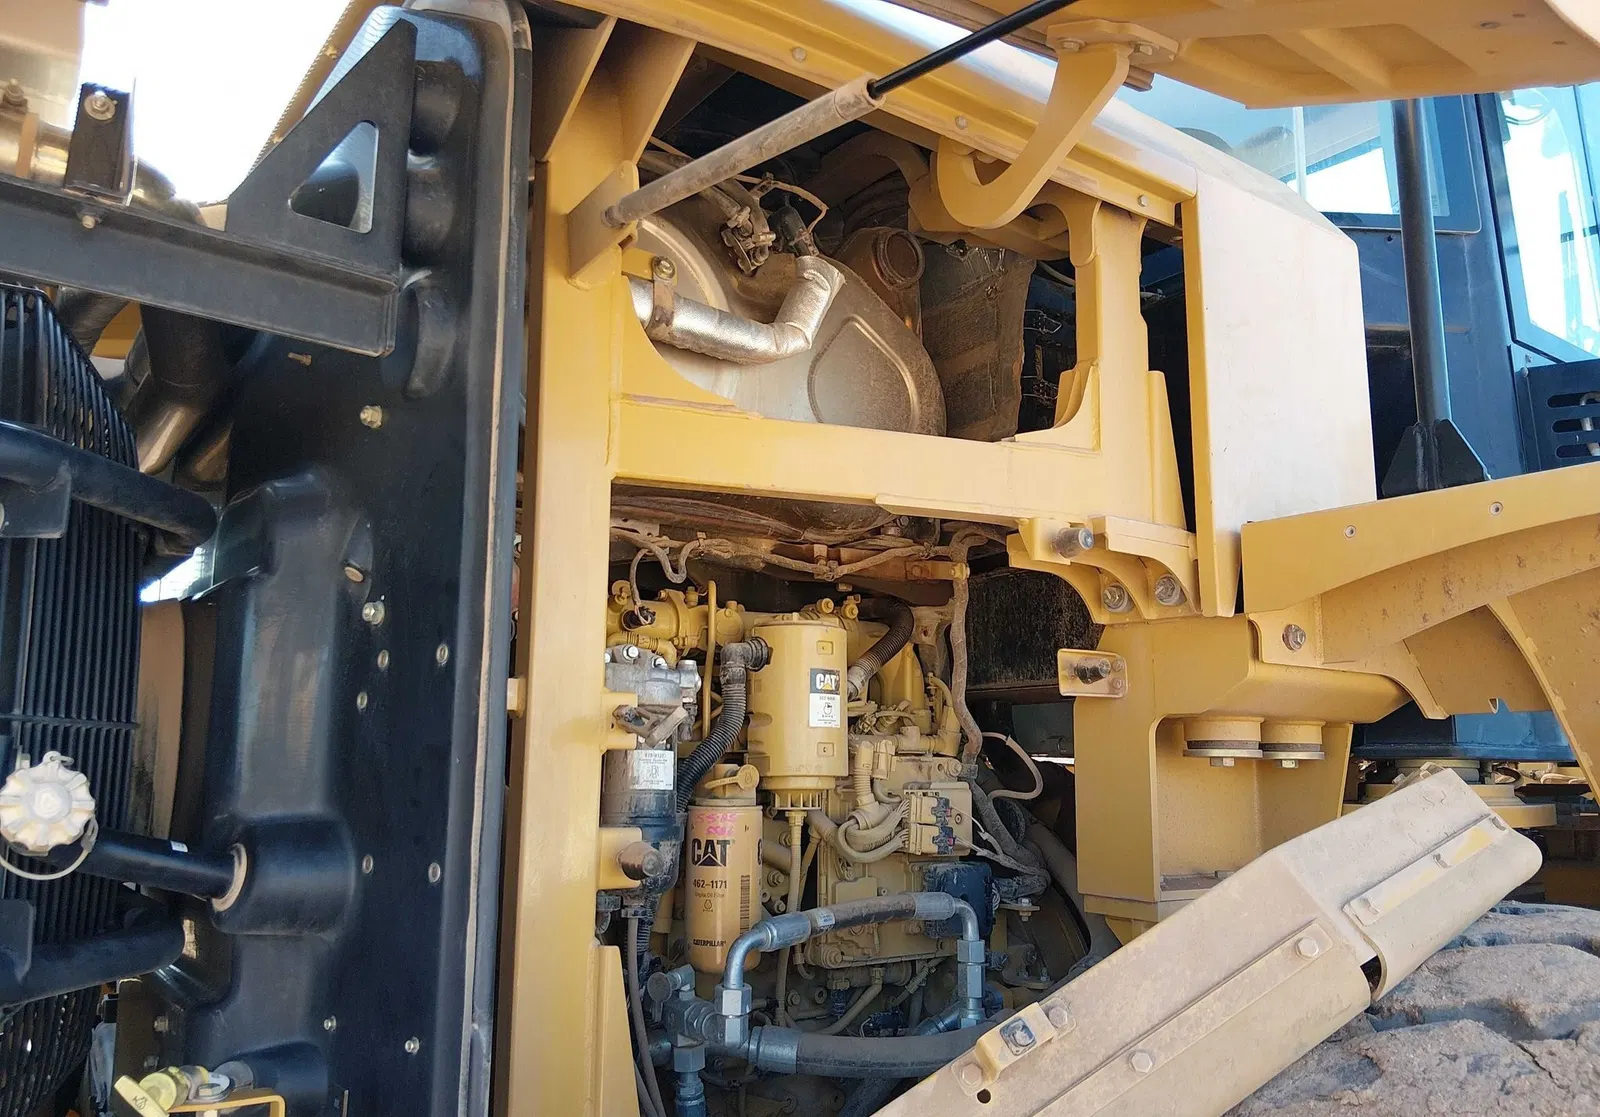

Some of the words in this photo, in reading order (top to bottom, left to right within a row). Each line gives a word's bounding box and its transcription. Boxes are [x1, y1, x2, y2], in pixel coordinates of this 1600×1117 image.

[815, 673, 837, 690] CAT
[692, 838, 730, 867] CAT
[692, 879, 727, 889] 462-1171
[693, 939, 726, 947] CATERPILLAR
